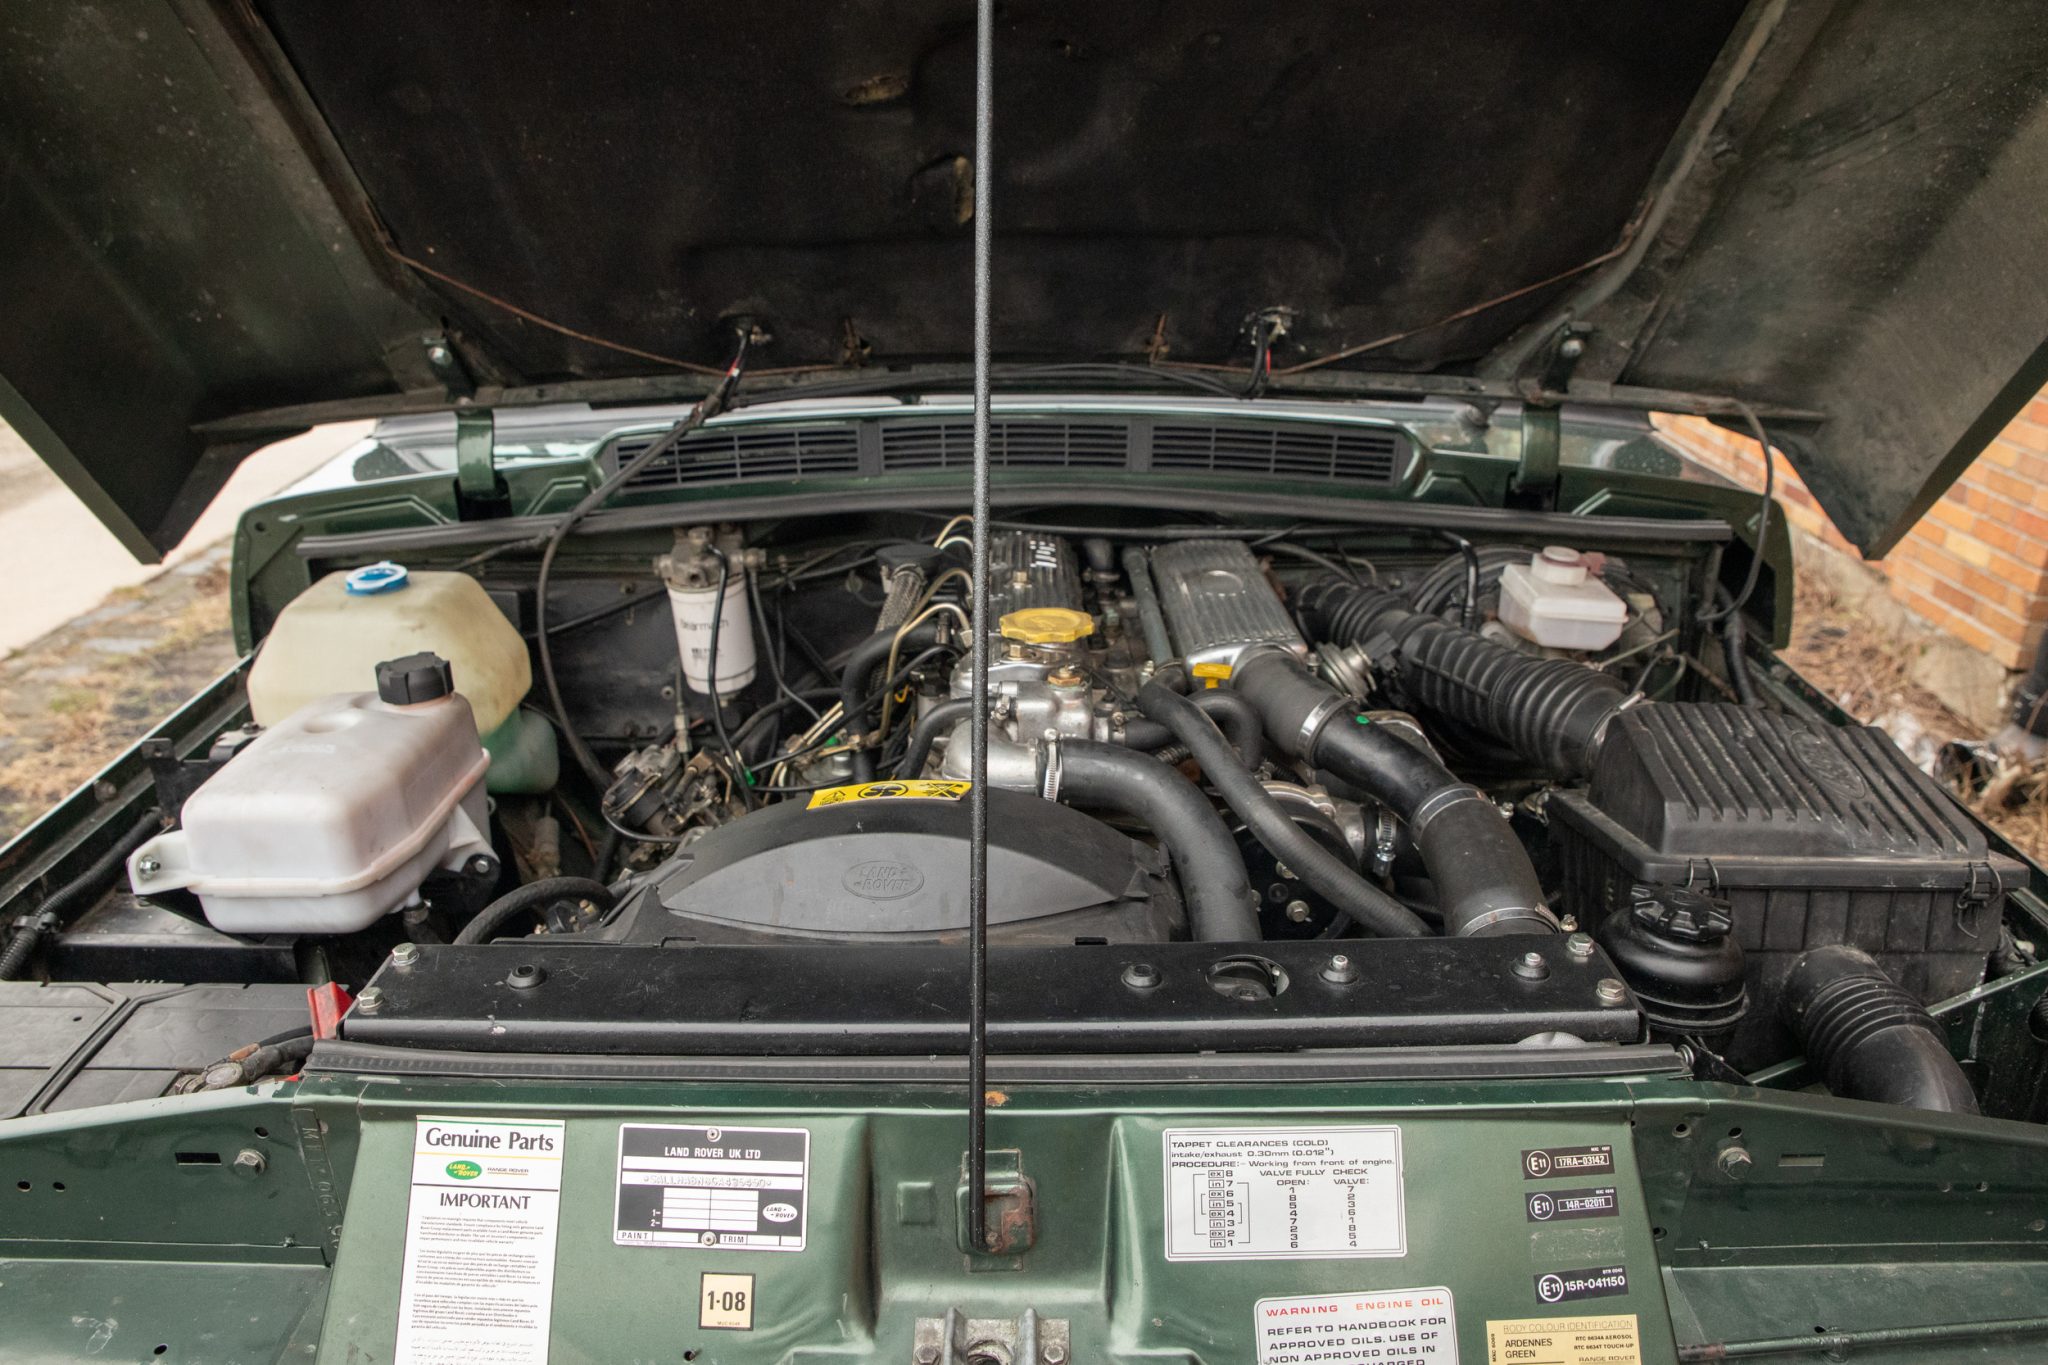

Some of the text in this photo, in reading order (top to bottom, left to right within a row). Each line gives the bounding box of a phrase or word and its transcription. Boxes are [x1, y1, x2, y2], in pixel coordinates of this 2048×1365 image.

[426, 1127, 554, 1151] Genuine Parts
[664, 1147, 761, 1159] LAND ROVER UK LTD
[1171, 1150, 1243, 1158] intake/exhaust
[1249, 1160, 1289, 1168] Working
[1362, 1159, 1395, 1167] engine.
[440, 1192, 531, 1210] IMPORTANT
[1565, 1198, 1605, 1209] 14R-02011
[621, 1231, 649, 1240] PAINT
[722, 1235, 745, 1243] TRIM
[1564, 1275, 1625, 1292] 15R-041150
[1266, 1298, 1444, 1317] WARNING ENGINE OIL
[1267, 1317, 1447, 1336] REFER TO HANDBOOK FOR
[1503, 1320, 1633, 1333] BODY COLOUR IDENTIFICATION
[1269, 1332, 1438, 1350] APPROVED OILS. USE OF
[1505, 1338, 1553, 1348] ARDENNES
[1269, 1345, 1436, 1364] NON APPROVED OILS IN
[1505, 1350, 1536, 1359] GREEN
